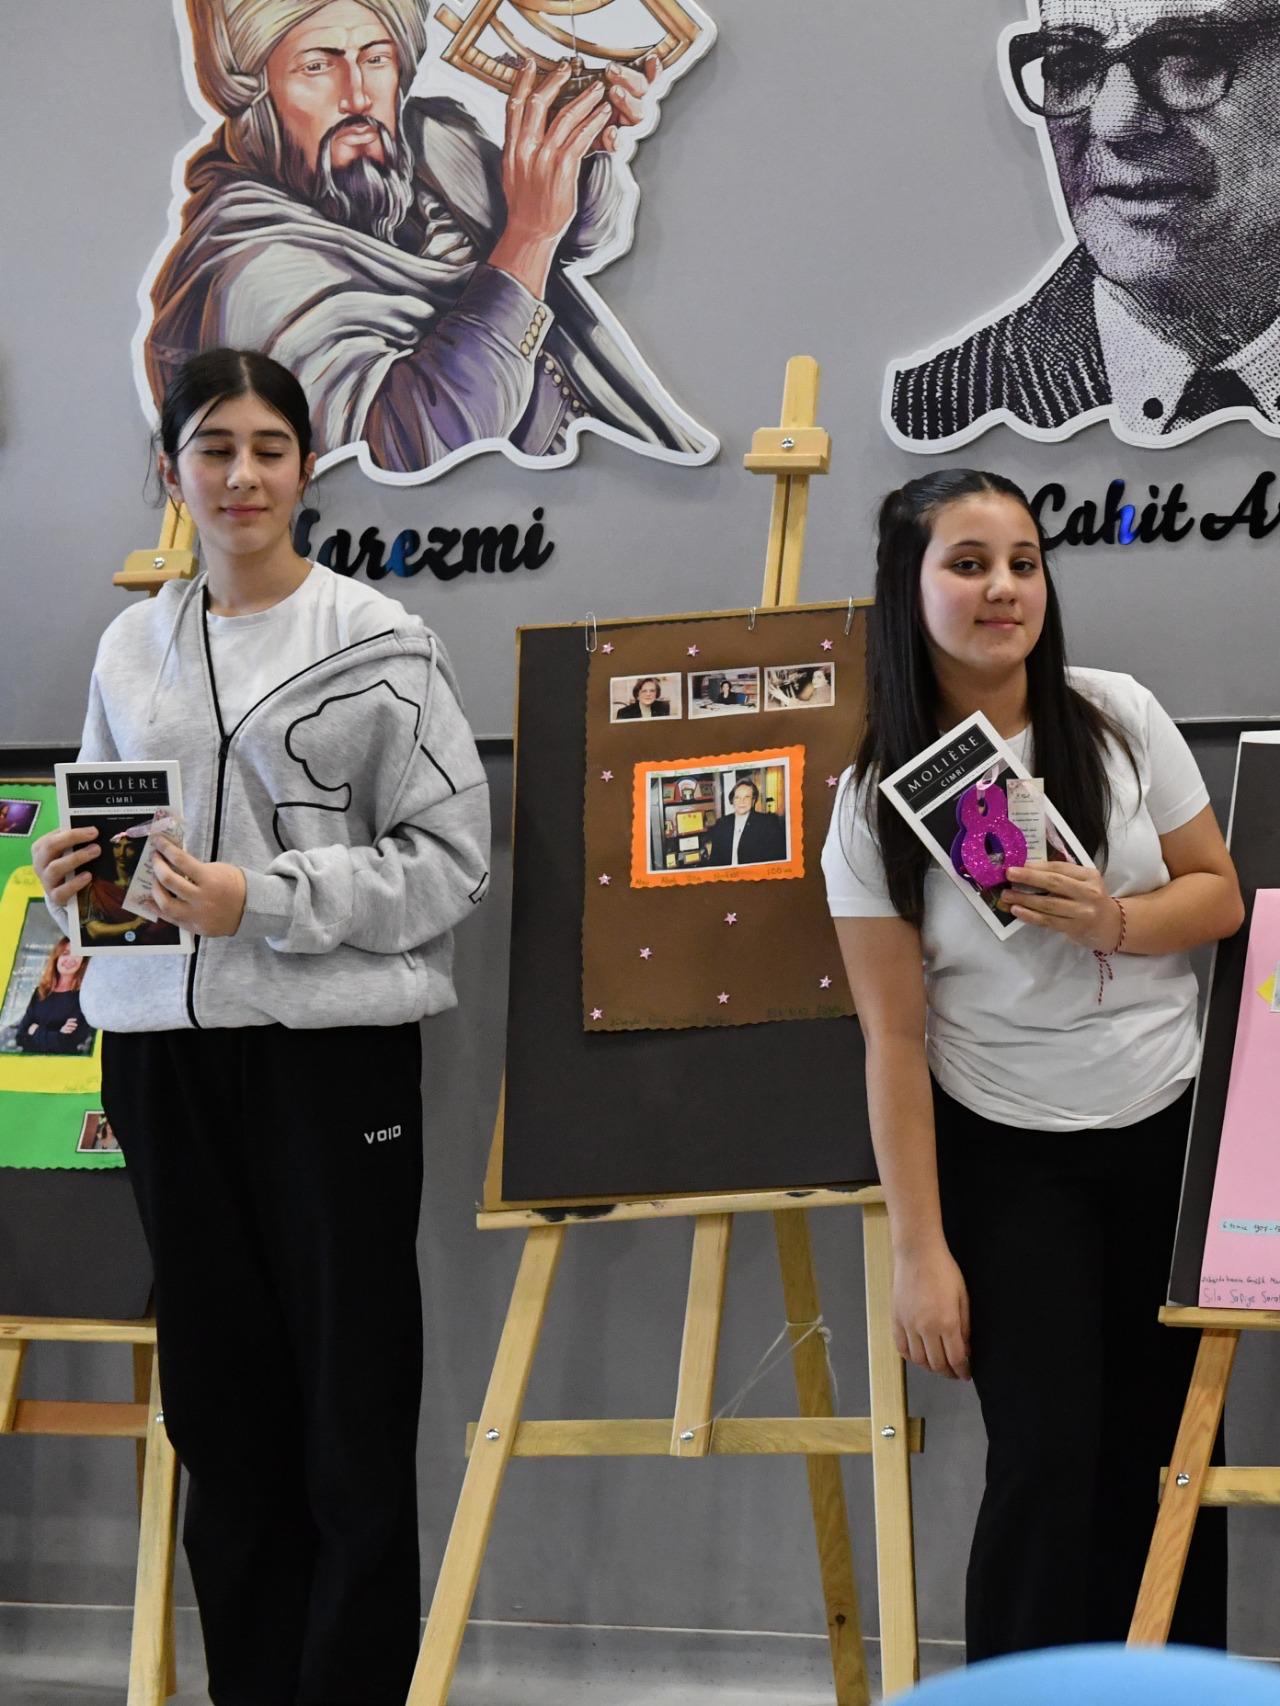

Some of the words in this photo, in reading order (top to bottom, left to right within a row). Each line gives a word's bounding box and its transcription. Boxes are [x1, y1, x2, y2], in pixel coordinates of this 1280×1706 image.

[1031, 479, 1195, 550] Cahit
[907, 735, 979, 793] MOLIÈRE
[78, 777, 159, 791] MOLIÈRE
[363, 1124, 402, 1145] VOID
